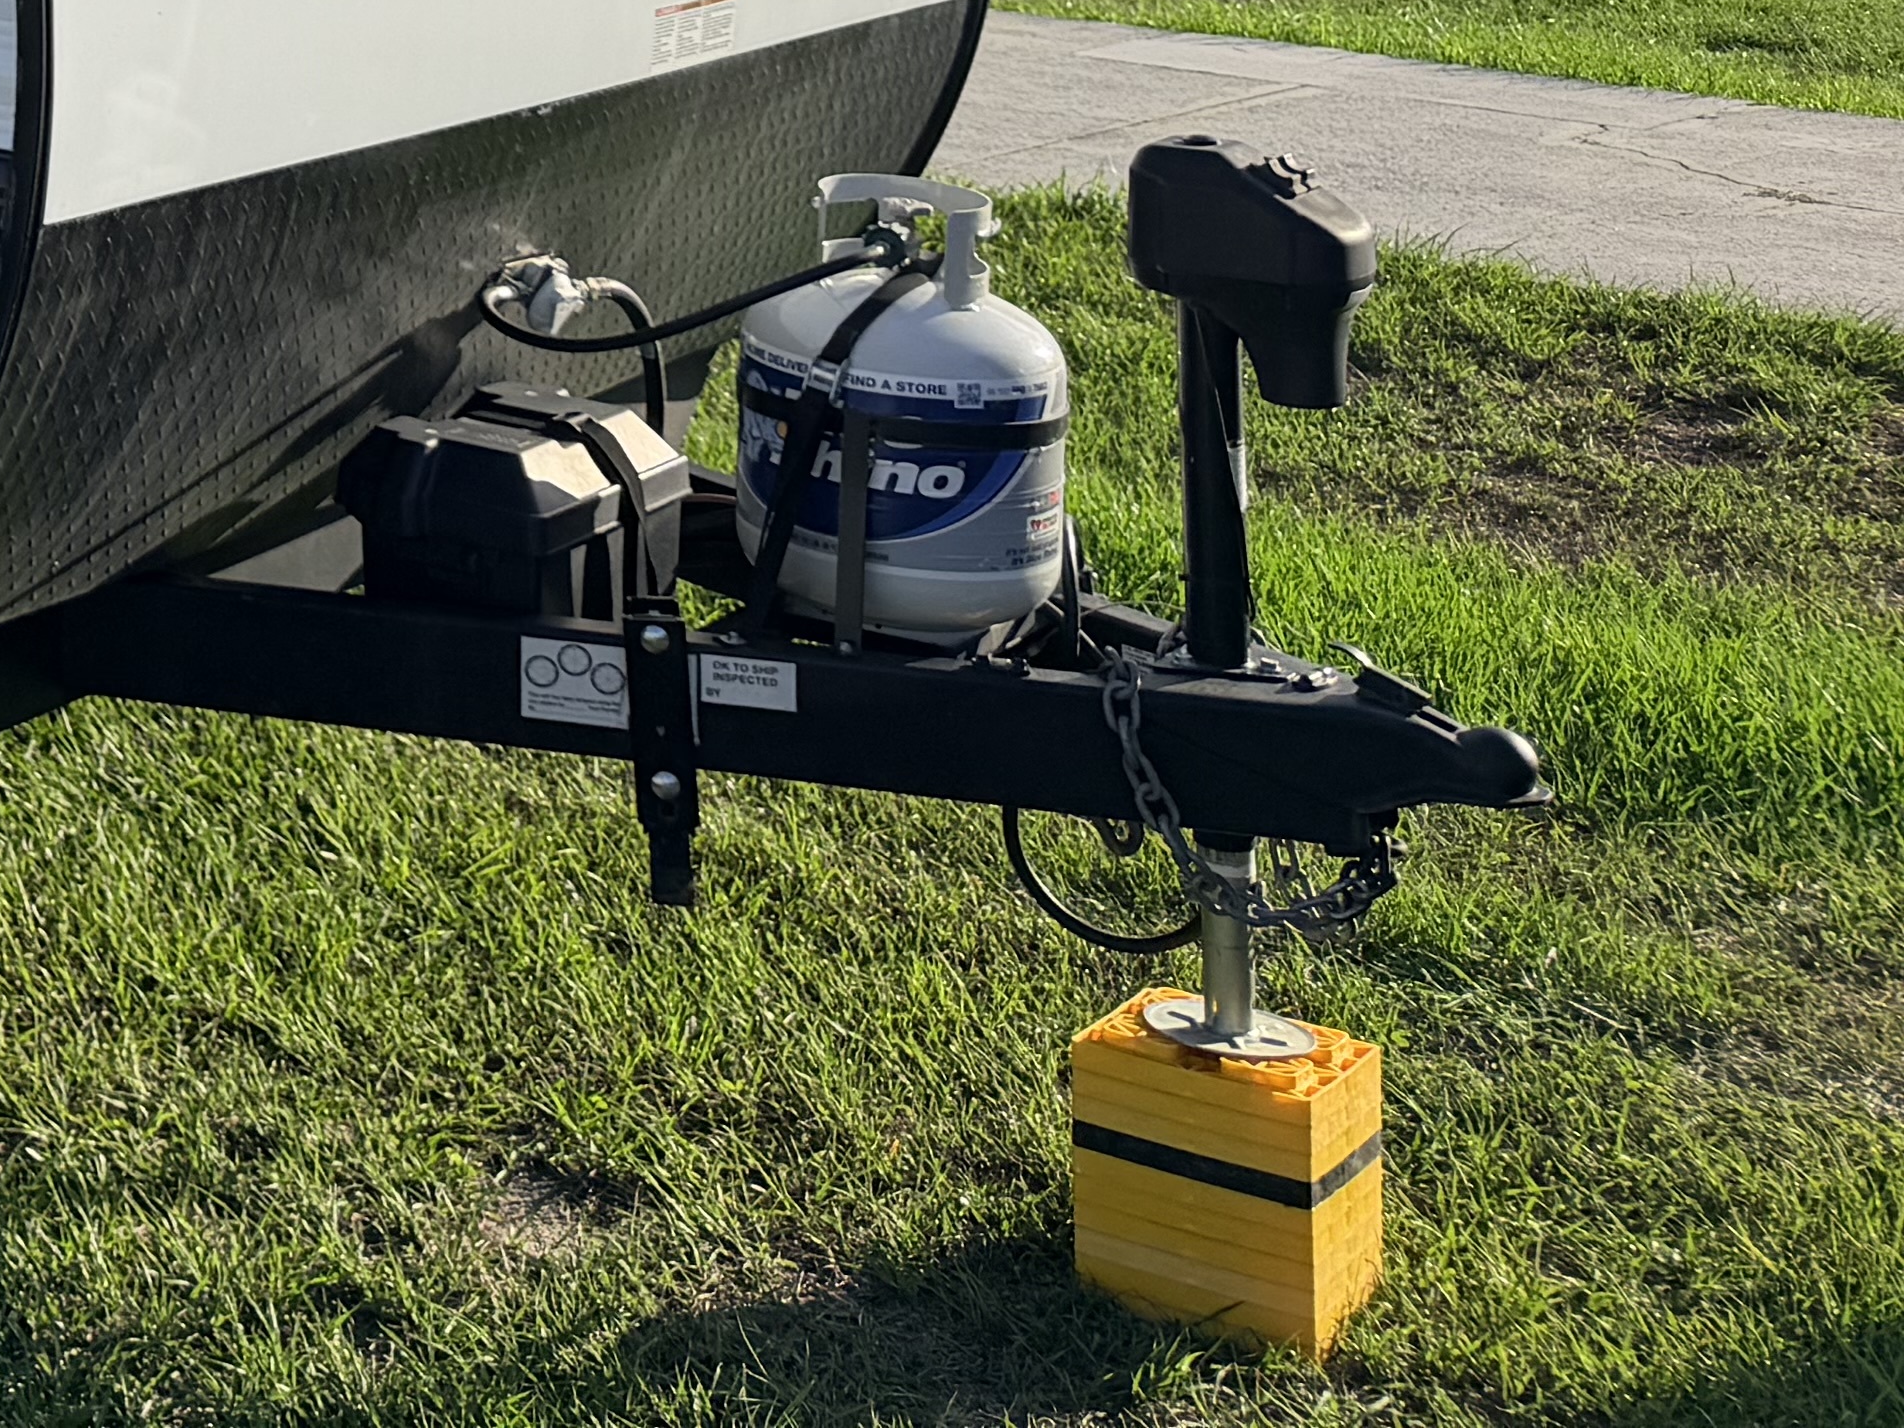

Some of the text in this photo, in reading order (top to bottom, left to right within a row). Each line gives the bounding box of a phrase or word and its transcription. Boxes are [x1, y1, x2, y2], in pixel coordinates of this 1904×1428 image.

[842, 371, 948, 396] FIND A STORE
[712, 660, 780, 676] OK TO SHIP
[712, 672, 779, 688] INSPECTED
[705, 686, 722, 698] BY
